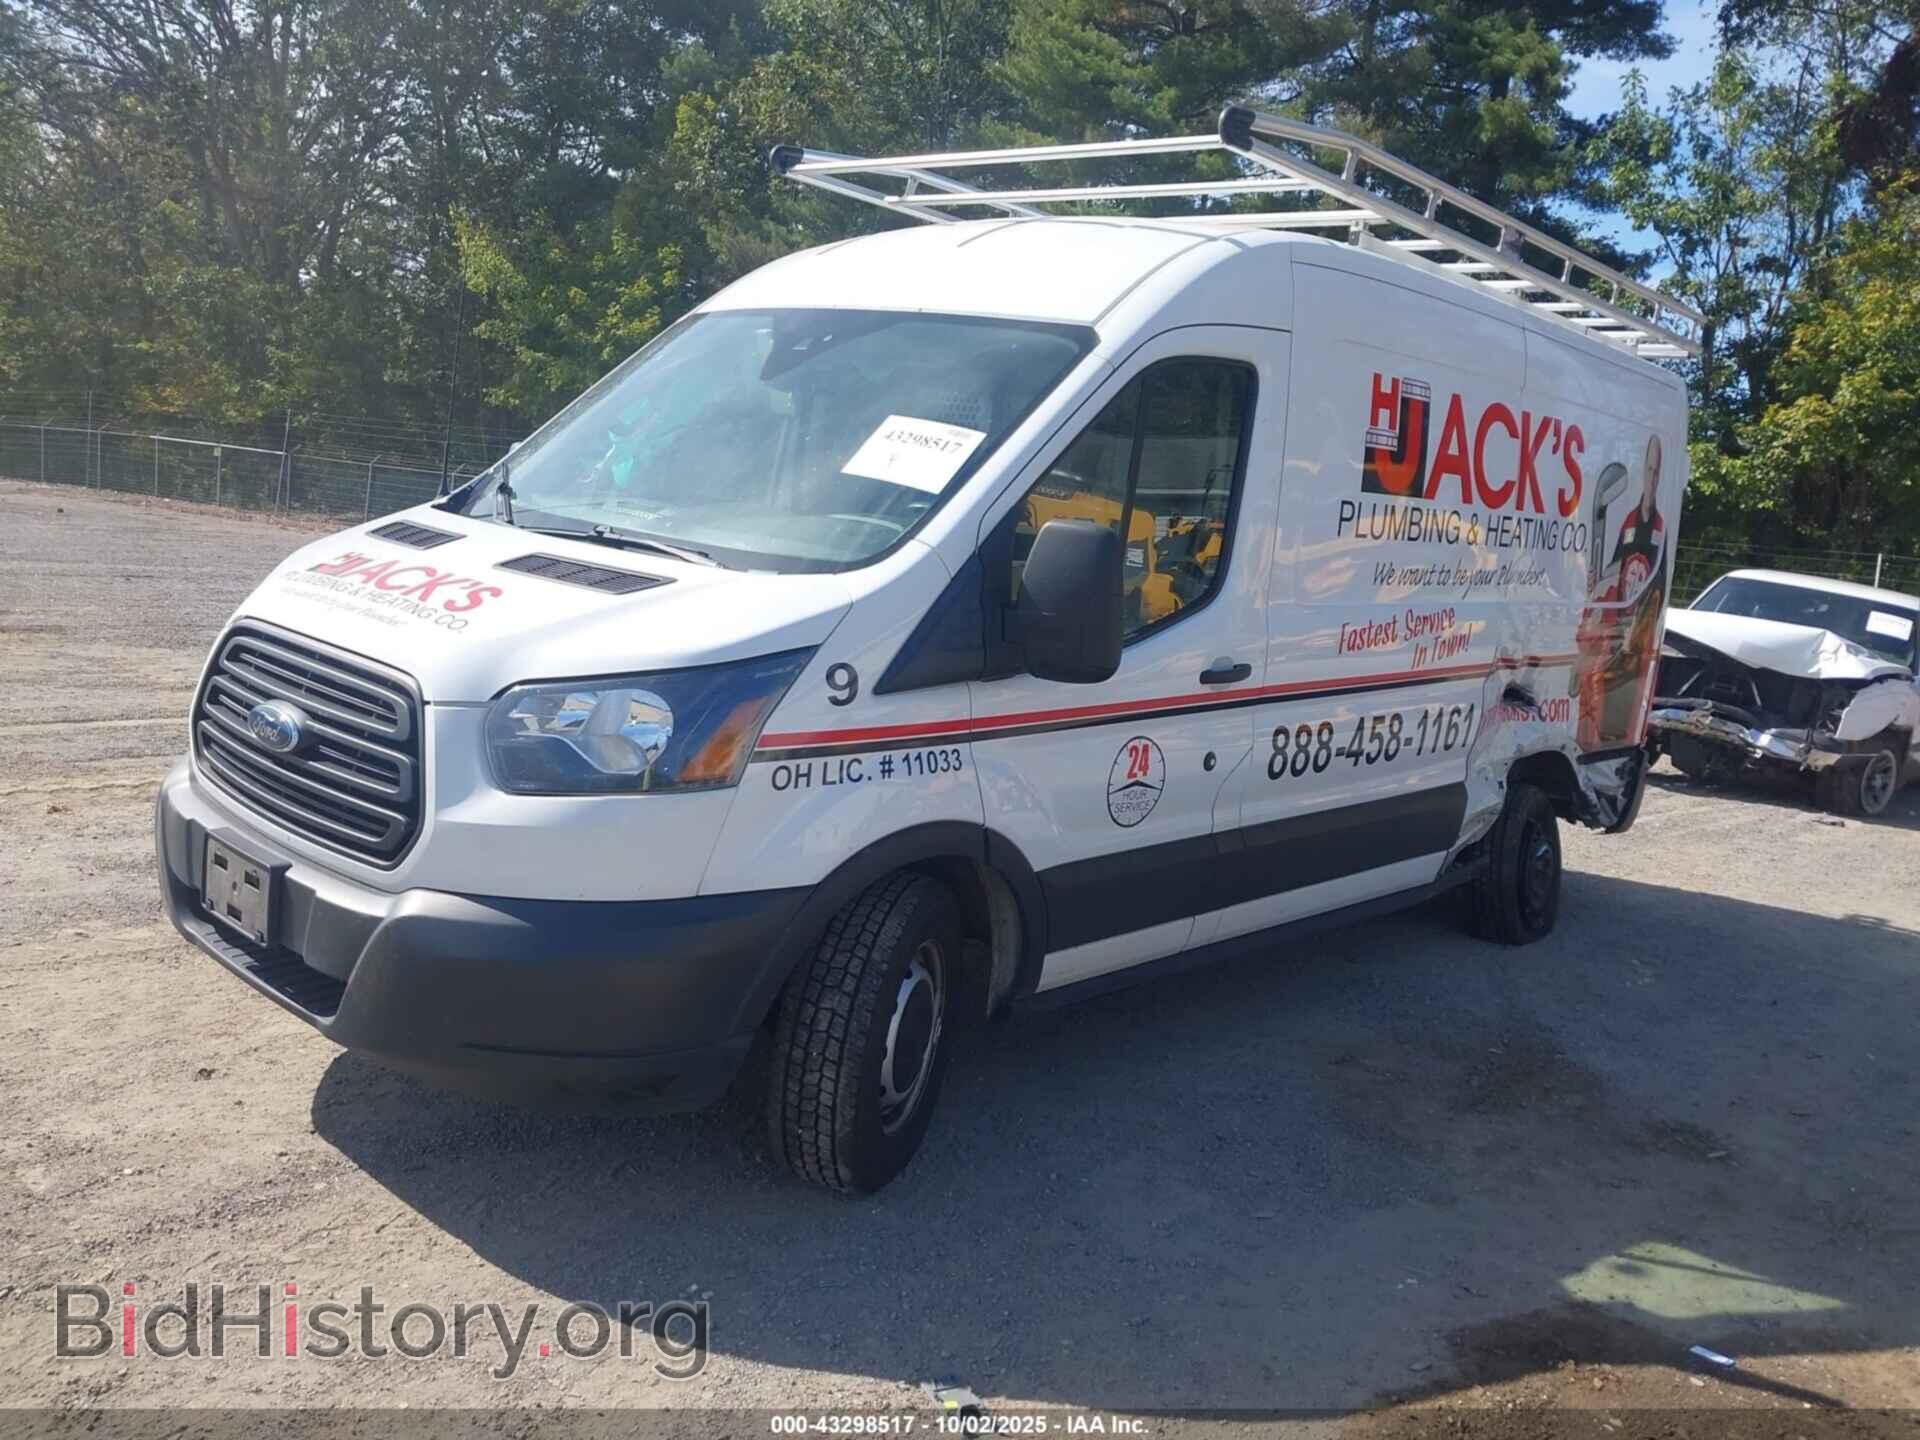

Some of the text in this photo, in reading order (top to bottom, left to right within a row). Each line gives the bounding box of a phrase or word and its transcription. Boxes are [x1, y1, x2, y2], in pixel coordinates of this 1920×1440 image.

[1337, 500, 1588, 554] PLUMBING & HEATING CO.
[1372, 560, 1395, 586] We
[1397, 563, 1436, 587] want
[1436, 562, 1451, 586] to
[1452, 557, 1468, 586] be
[1338, 607, 1456, 655] Fastest Service
[1411, 623, 1472, 669] In Town!
[825, 662, 859, 707] 9
[1127, 743, 1150, 779] 24
[1267, 703, 1475, 781] 888-458-1161
[771, 749, 963, 791] OH LIC. # 11033
[1114, 800, 1150, 815] SERVICE
